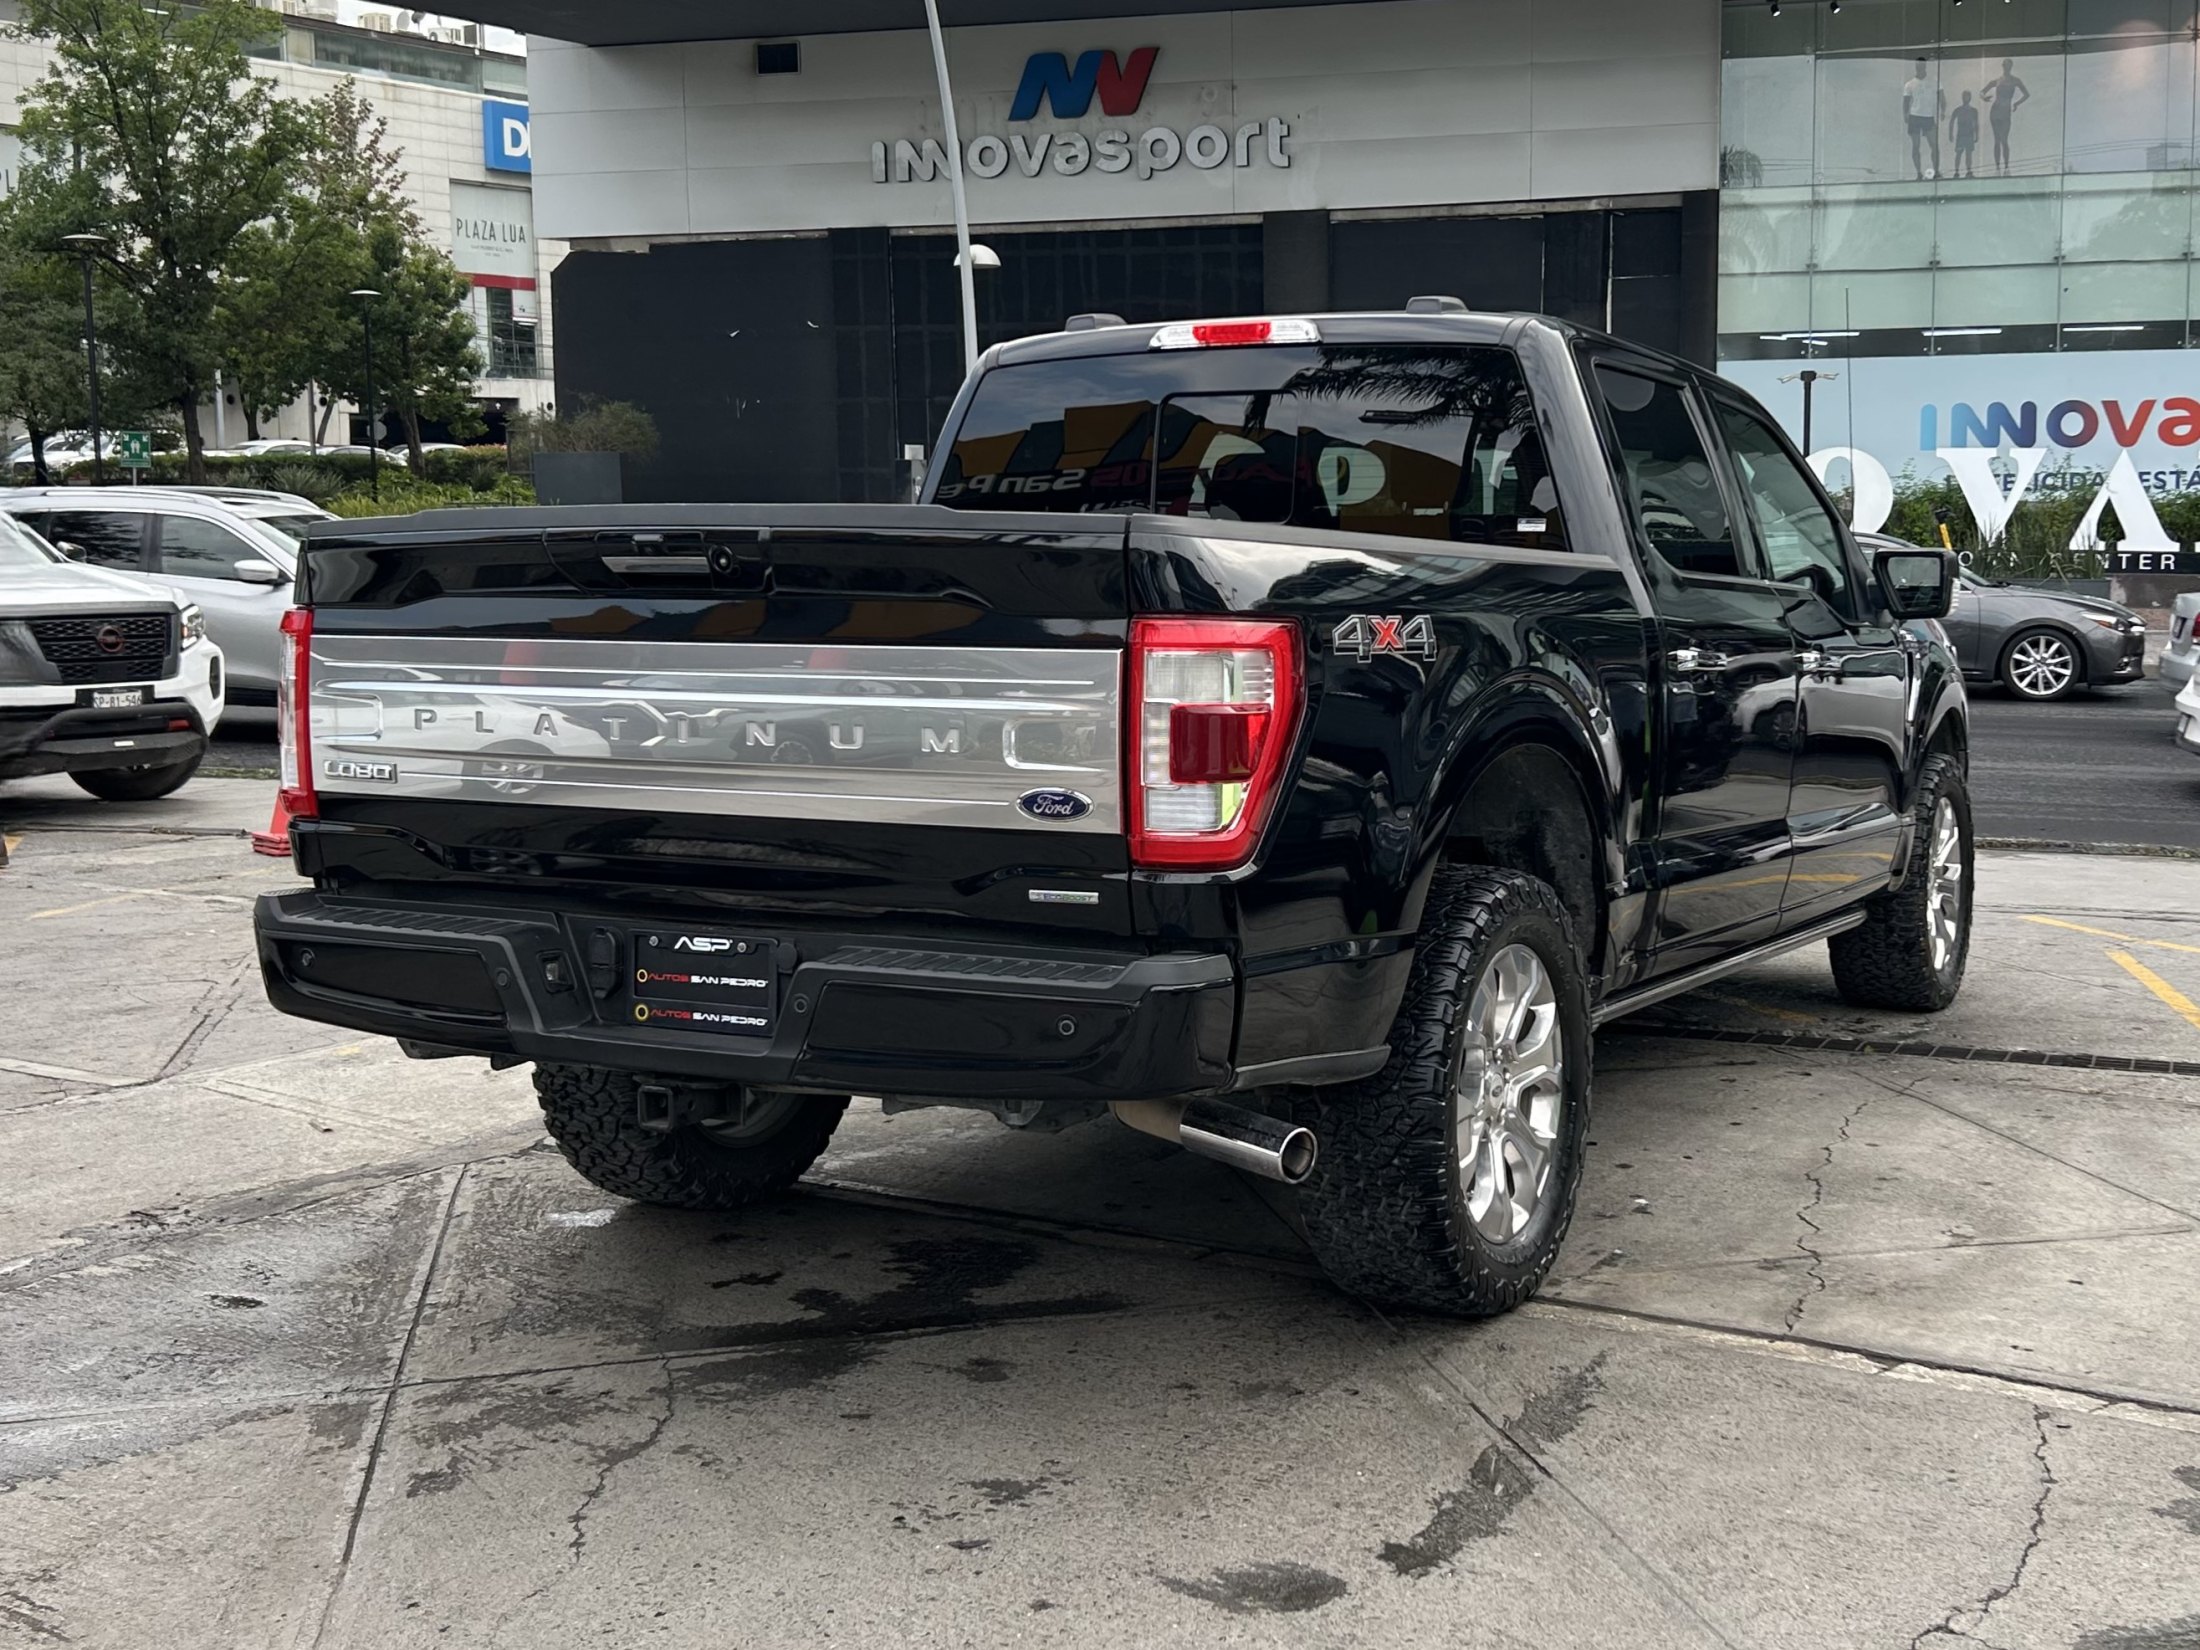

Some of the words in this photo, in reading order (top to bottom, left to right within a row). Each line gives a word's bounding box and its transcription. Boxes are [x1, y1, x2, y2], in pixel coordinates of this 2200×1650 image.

[502, 117, 531, 159] D
[456, 218, 497, 242] PLAZA
[501, 224, 527, 243] LUA
[2054, 552, 2176, 570] ENTER
[414, 707, 960, 753] PLATINUM
[324, 761, 392, 779] LOBO
[1033, 794, 1074, 817] Ford
[674, 936, 730, 952] ASP
[648, 972, 689, 983] AUTOS
[690, 975, 719, 985] SAN
[720, 977, 767, 988] PEDRO
[650, 1008, 691, 1019] AUTOS
[692, 1012, 719, 1022] SAN
[721, 1014, 767, 1026] PEDRO
